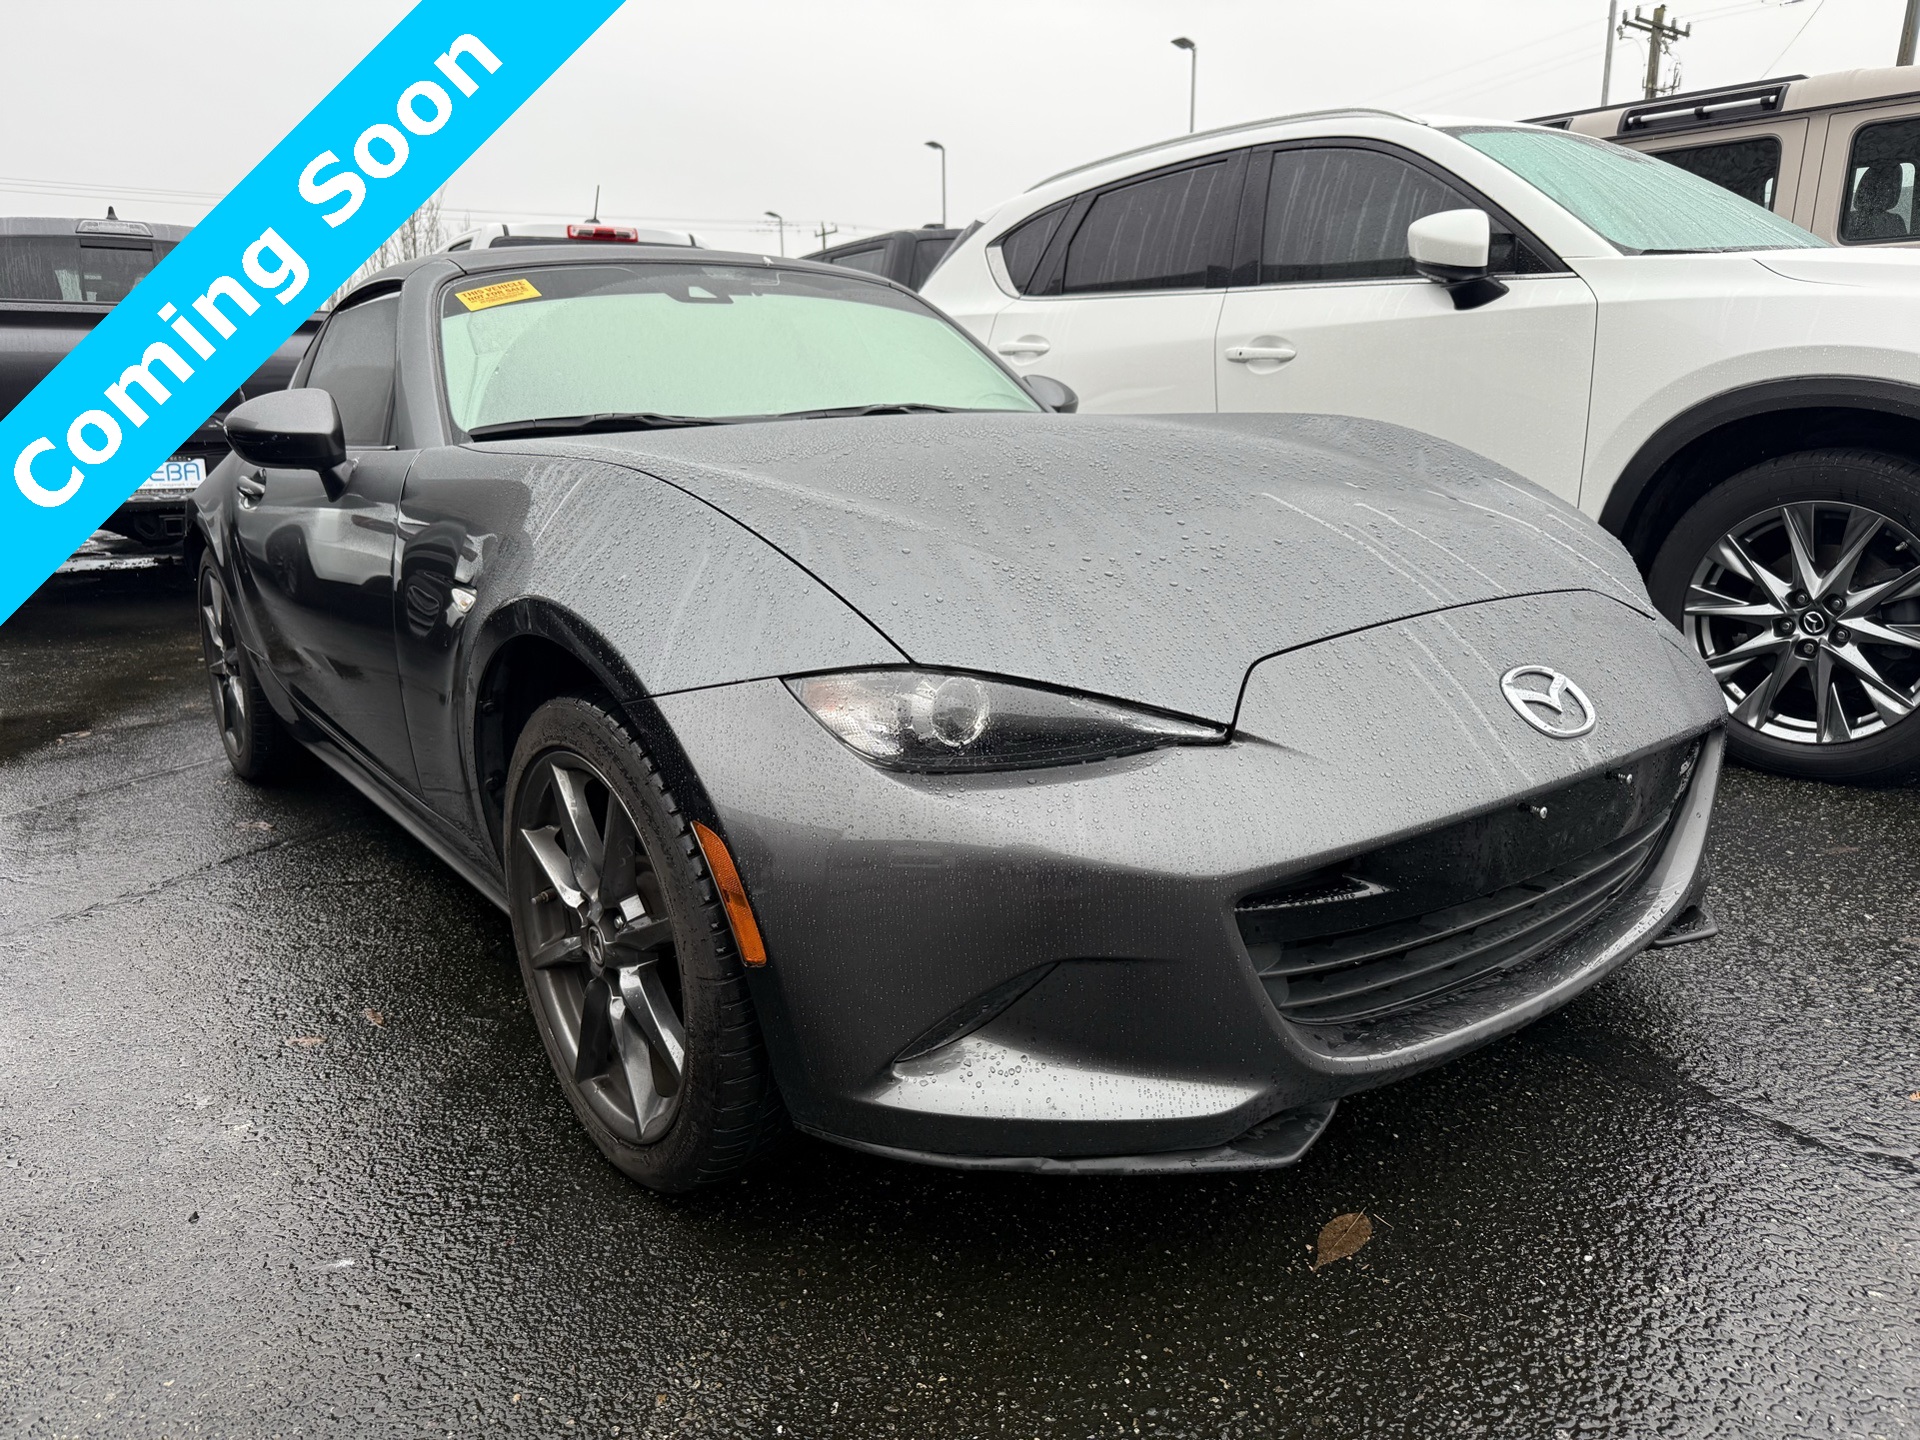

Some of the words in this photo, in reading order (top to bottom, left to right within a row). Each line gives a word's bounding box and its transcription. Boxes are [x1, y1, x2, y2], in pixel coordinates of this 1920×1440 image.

[461, 289, 484, 298] THIS
[485, 281, 526, 293] VEHICLE
[467, 294, 484, 302] NOT
[486, 290, 504, 298] FOR
